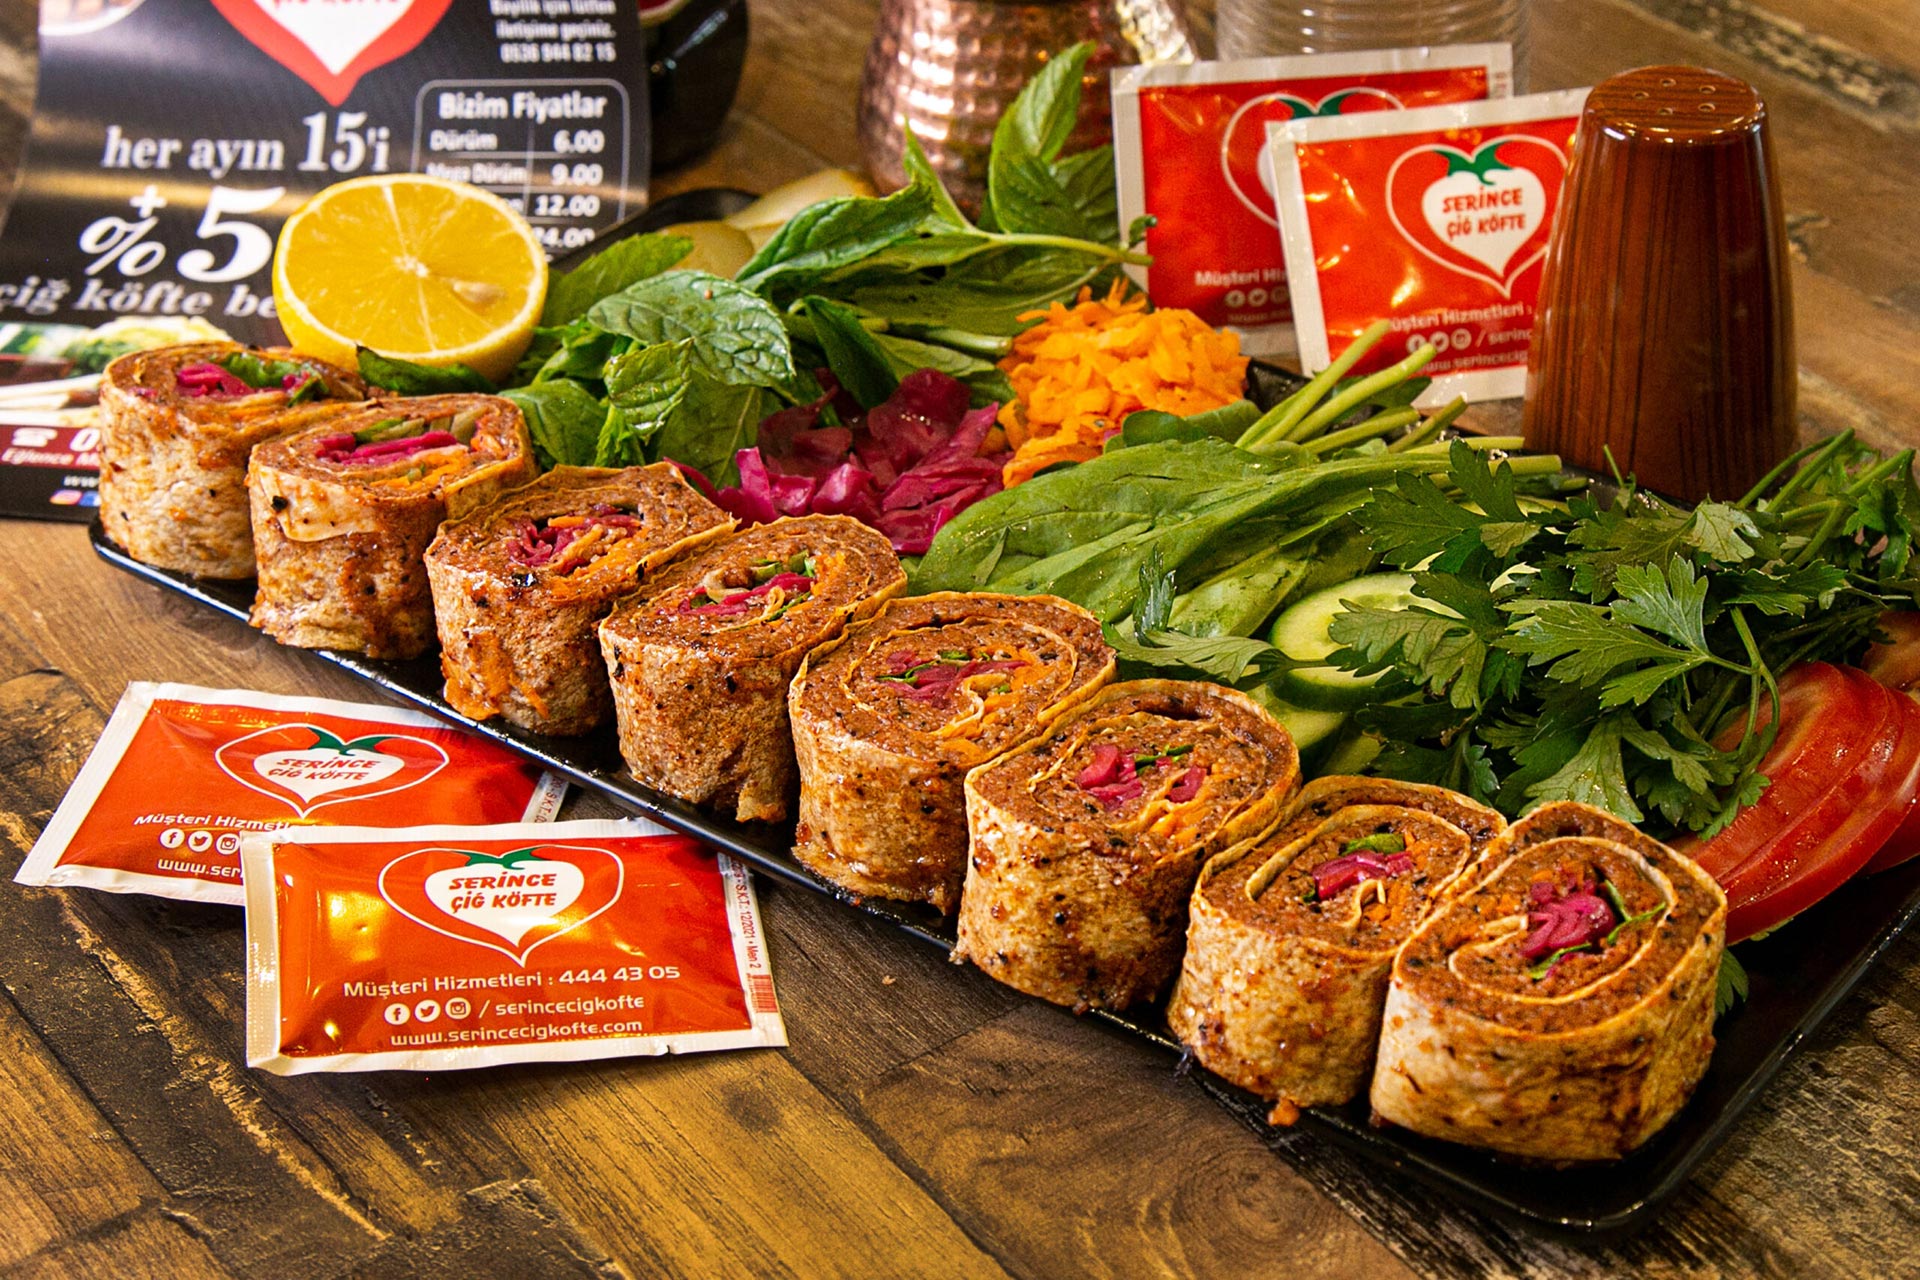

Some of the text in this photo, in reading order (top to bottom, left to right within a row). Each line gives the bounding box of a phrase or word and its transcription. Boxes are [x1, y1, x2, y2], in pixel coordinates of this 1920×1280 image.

[438, 89, 608, 124] Bizim Fiyatlar
[102, 111, 390, 179] her ayın 15'i
[430, 129, 605, 153] Dürüm 6.00
[472, 162, 527, 184] Dürüm
[551, 163, 603, 186] 9.00
[534, 195, 600, 217] 12.00
[1442, 185, 1523, 213] SERİNCE
[1477, 212, 1526, 235] KÖFTE
[1194, 269, 1260, 289] Müşteri
[73, 278, 213, 314] köfte
[223, 284, 276, 318] be
[1391, 312, 1440, 333] üşteri
[1442, 301, 1524, 326] Hizmetleri
[1488, 328, 1532, 345] serinc
[276, 756, 381, 769] SERİNCE
[304, 769, 369, 781] KÖFTE
[134, 813, 290, 832] Müşteri Hizmetl
[157, 858, 242, 879] www.ser
[449, 872, 557, 913] SERİNCE ÇİĞ KÖFTE
[740, 911, 756, 938] 12/2021
[343, 980, 428, 1000] Müşteri
[434, 971, 542, 992] Hizmetleri
[558, 969, 606, 985] 444
[613, 967, 643, 982] 43
[648, 965, 681, 980] 05
[495, 995, 645, 1016] serincecigkofte
[390, 1019, 643, 1046] www.serincecigkofte.com
